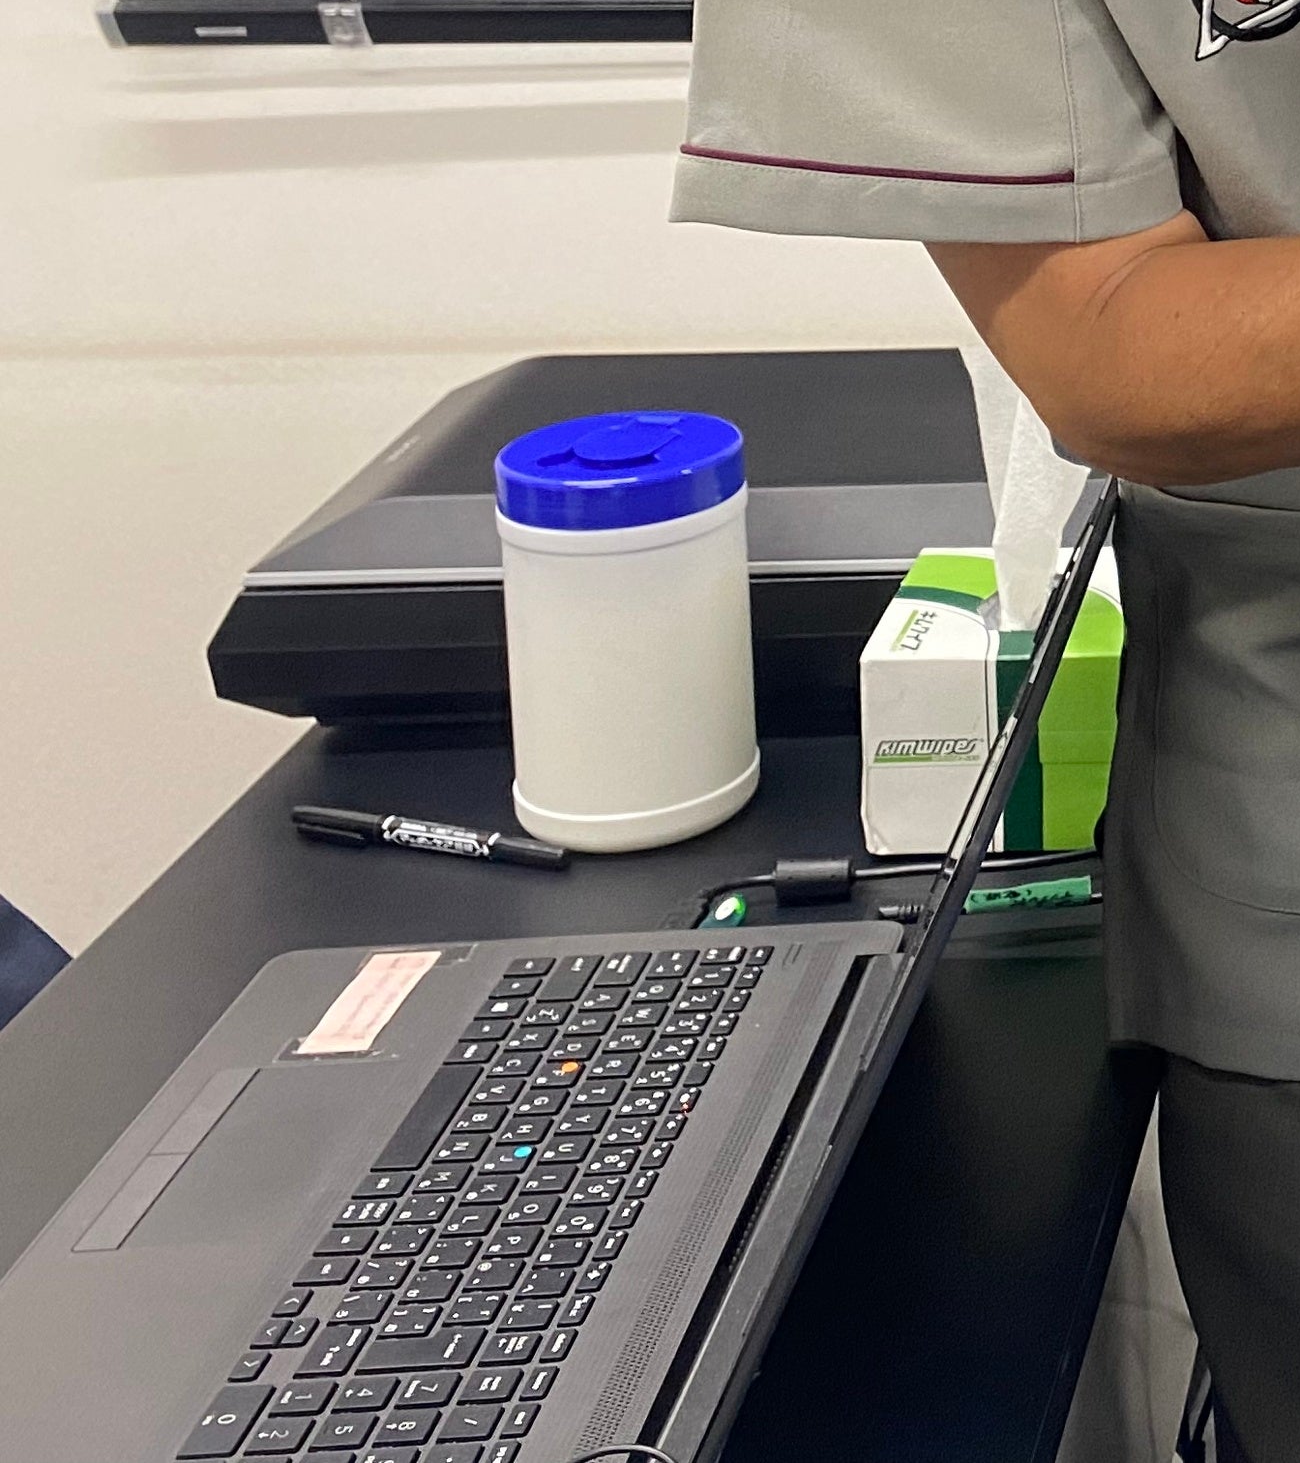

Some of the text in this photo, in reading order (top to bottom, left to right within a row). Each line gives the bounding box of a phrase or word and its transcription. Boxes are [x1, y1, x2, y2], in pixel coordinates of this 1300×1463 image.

[596, 993, 611, 1002] A
[538, 1008, 555, 1018] Z
[581, 1018, 597, 1026] S
[678, 1019, 694, 1027] 3
[522, 1033, 539, 1041] X
[620, 1034, 636, 1042] E
[566, 1043, 582, 1052] D
[506, 1058, 522, 1067] C
[650, 1070, 666, 1078] 5
[490, 1084, 506, 1094] V
[591, 1086, 606, 1094] T
[533, 1096, 549, 1106] G
[634, 1097, 651, 1106] 6
[471, 1113, 488, 1122] B
[516, 1124, 533, 1133] H
[620, 1125, 637, 1134] 7
[558, 1143, 575, 1152] U
[603, 1154, 620, 1164] 8
[480, 1184, 497, 1193] K
[587, 1184, 604, 1194] 9
[523, 1203, 539, 1214] O
[461, 1215, 479, 1224] L
[570, 1216, 587, 1226] 0
[507, 1235, 522, 1245] P
[420, 1383, 439, 1392] 7
[356, 1388, 373, 1397] 4
[217, 1413, 237, 1425] 0
[334, 1425, 354, 1435] 5
[397, 1421, 417, 1431] 8
[269, 1429, 289, 1439] 2
